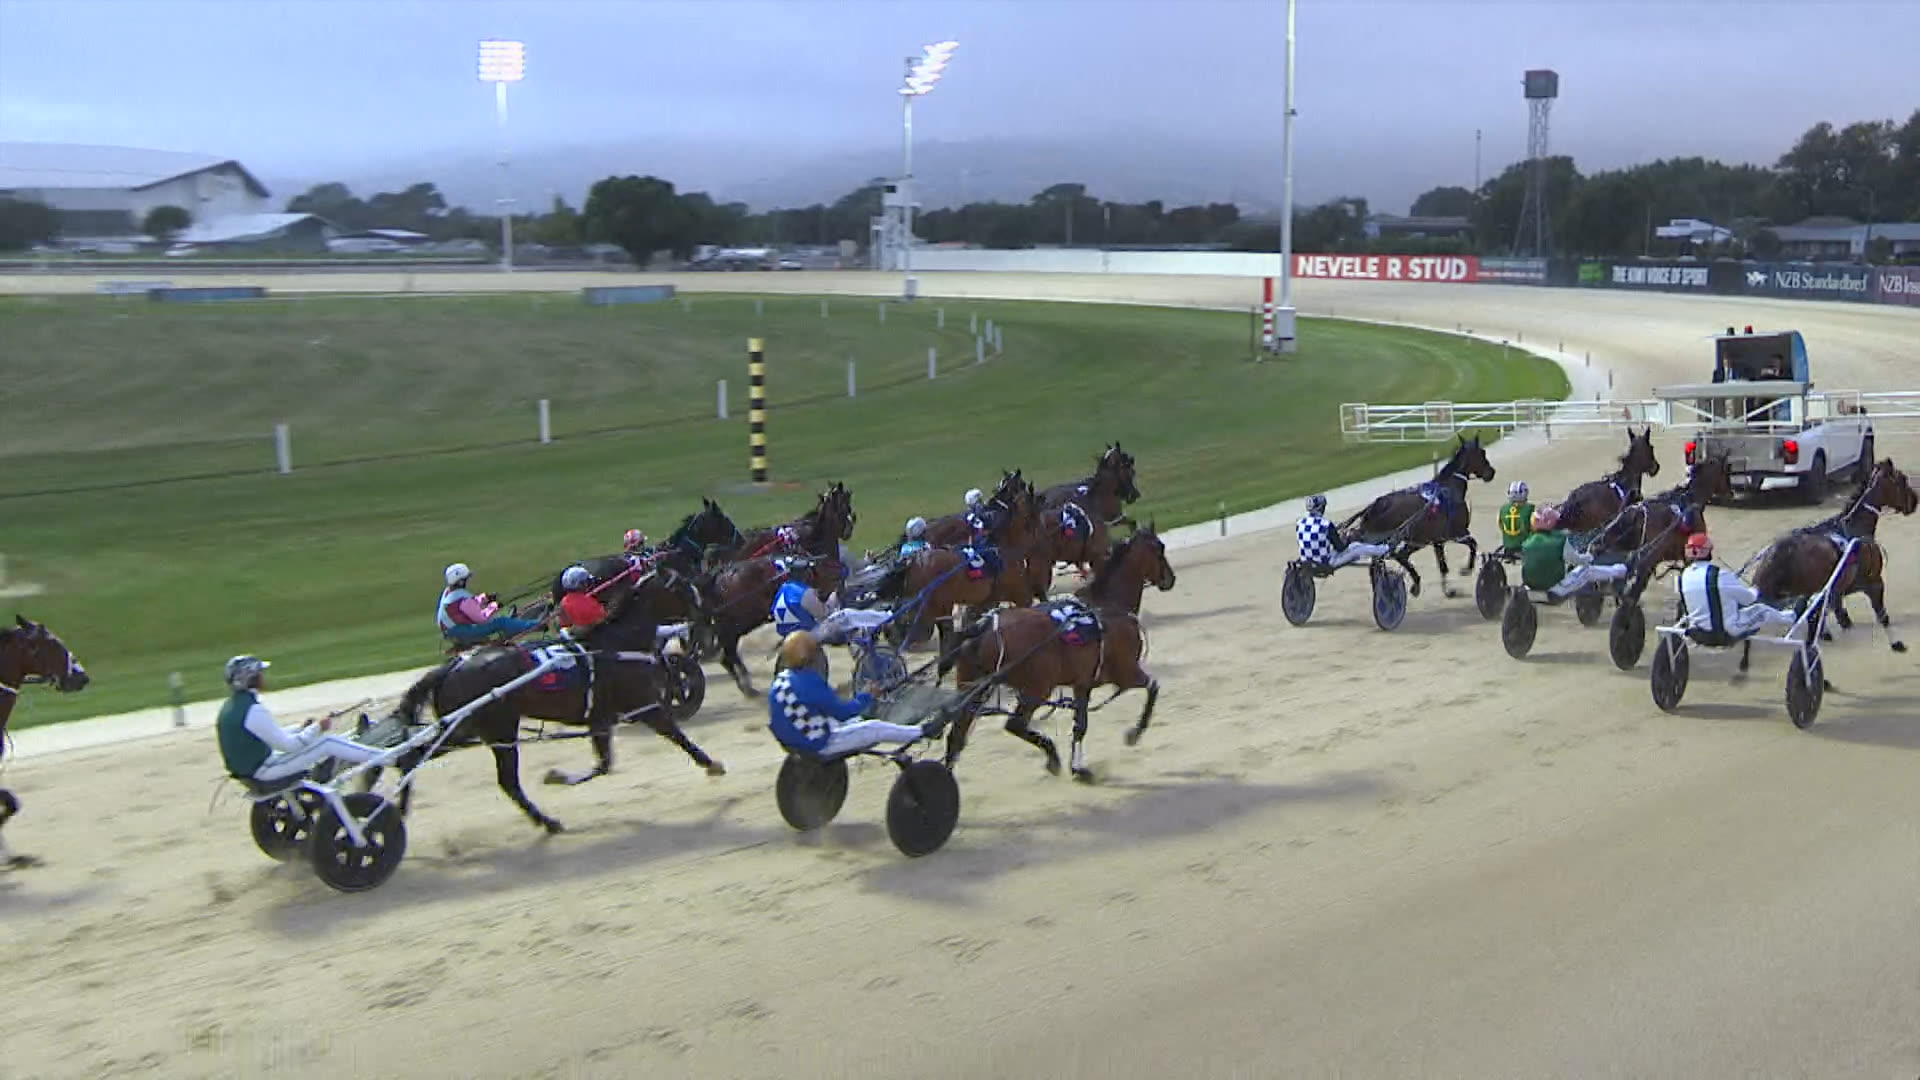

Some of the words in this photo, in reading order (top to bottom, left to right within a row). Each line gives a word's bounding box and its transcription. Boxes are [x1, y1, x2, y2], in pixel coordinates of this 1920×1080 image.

[1297, 256, 1379, 278] NEVELE
[1386, 258, 1402, 278] R
[1408, 257, 1467, 280] STUD
[1681, 267, 1708, 286] SPORT
[1775, 271, 1800, 288] NZB
[1802, 272, 1868, 291] Standardbred
[1880, 273, 1902, 292] NZB
